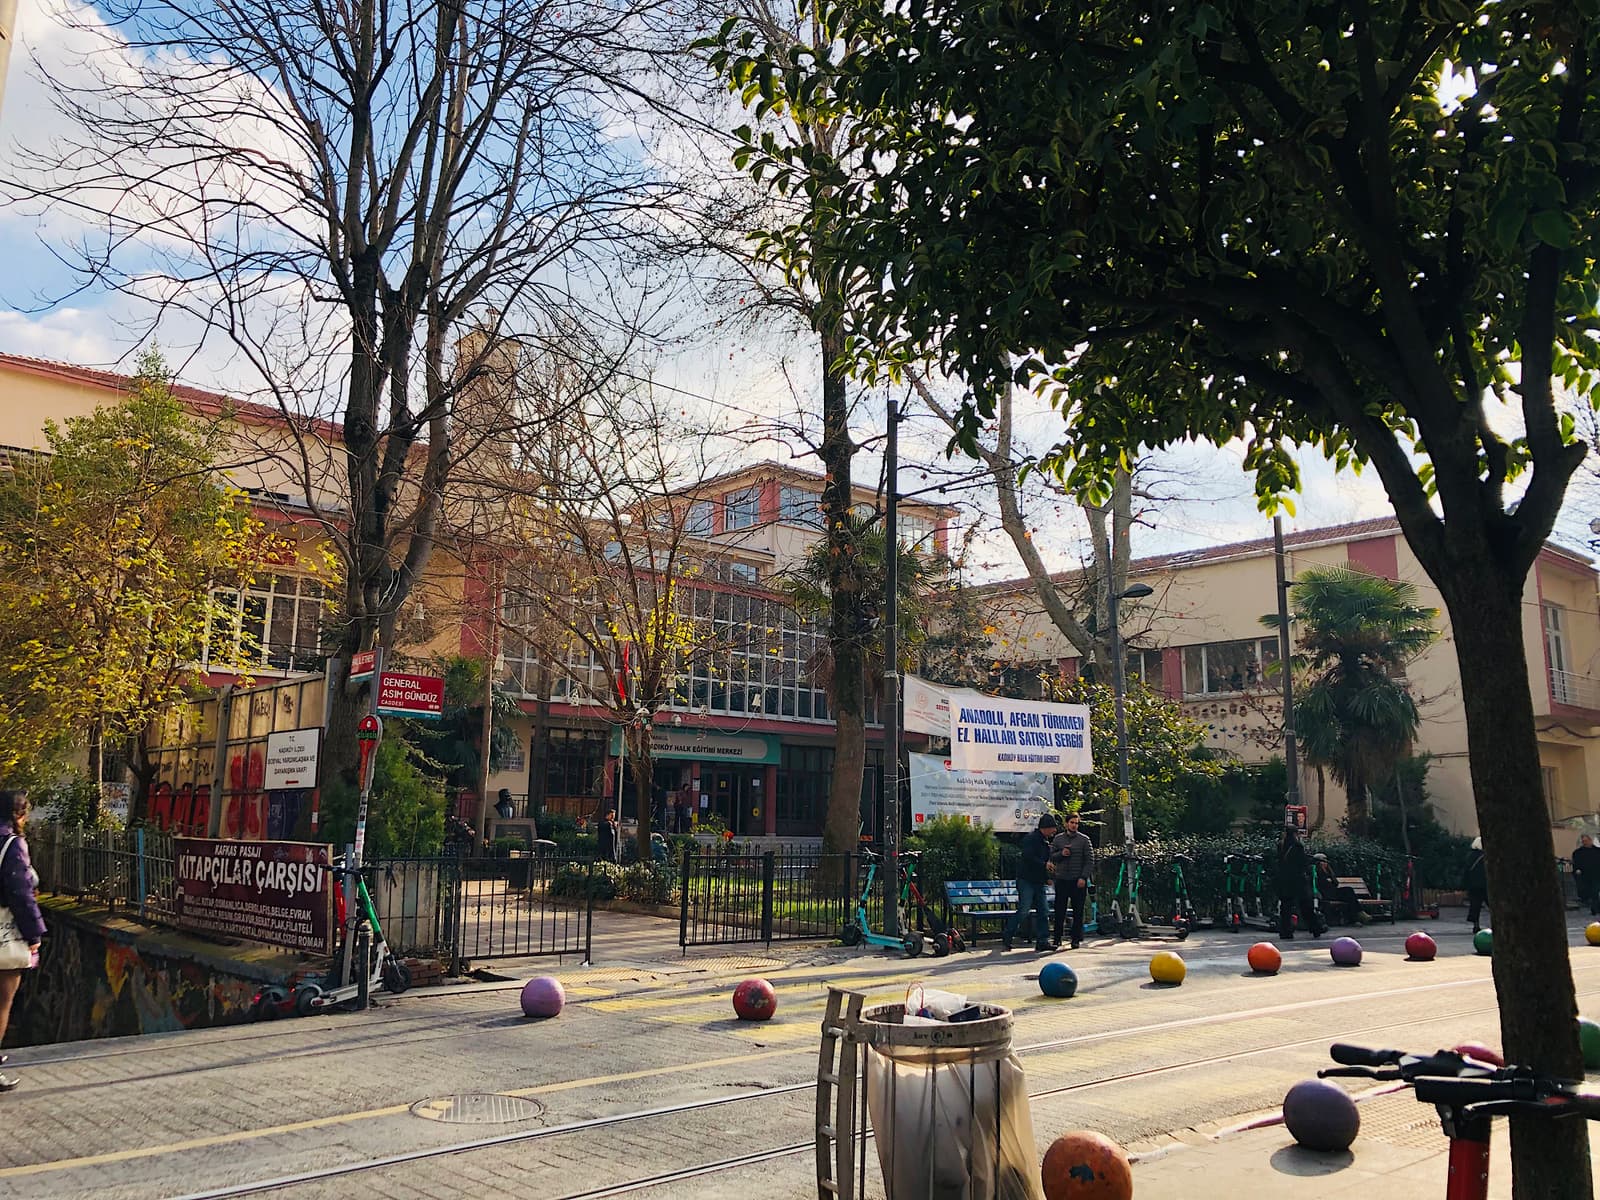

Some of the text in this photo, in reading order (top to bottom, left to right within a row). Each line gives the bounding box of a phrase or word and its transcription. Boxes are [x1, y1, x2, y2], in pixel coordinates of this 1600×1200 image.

[383, 677, 421, 690] GENERAL
[382, 689, 438, 703] ASIM GÜNDÜZ
[959, 707, 1007, 728] ANADOLU,
[1010, 711, 1039, 728] AFGAN
[1041, 711, 1084, 731] TÜRKMEN
[957, 727, 970, 743] EL
[974, 728, 1017, 745] HALILARI
[1019, 731, 1053, 749] SATIŞLI
[650, 742, 673, 751] ADIKÖY
[674, 744, 691, 753] HALK
[716, 747, 743, 756] MERKEZİ
[214, 844, 262, 858] KAFKAS PASAJI
[179, 849, 323, 898] KİTAPÇILAR ÇARŞISI
